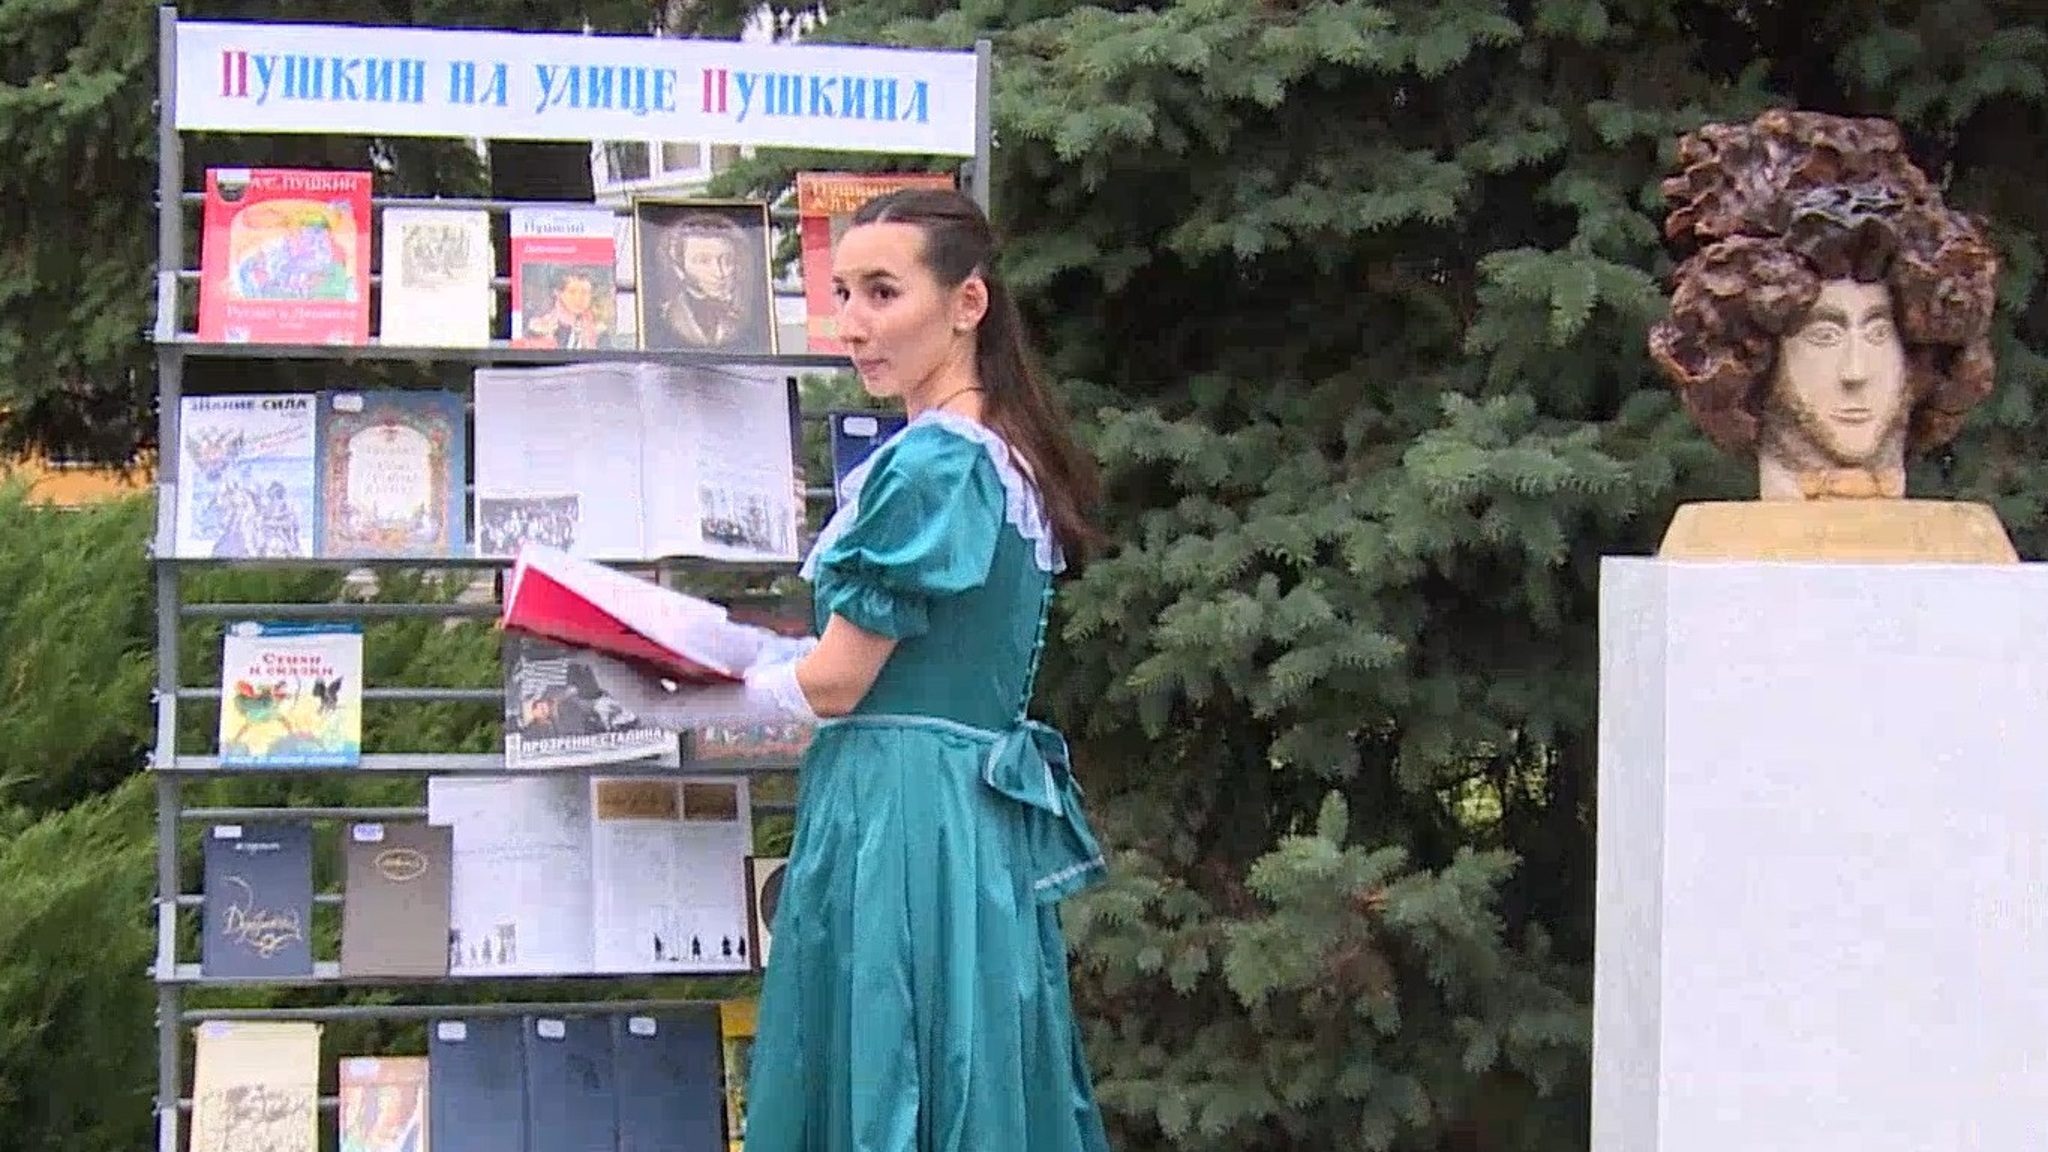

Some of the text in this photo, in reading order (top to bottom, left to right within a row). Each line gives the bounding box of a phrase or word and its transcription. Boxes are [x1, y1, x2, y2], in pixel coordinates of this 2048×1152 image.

[219, 50, 929, 123] ПУШКИН НА УЛИЦЕ ПУШКИНА
